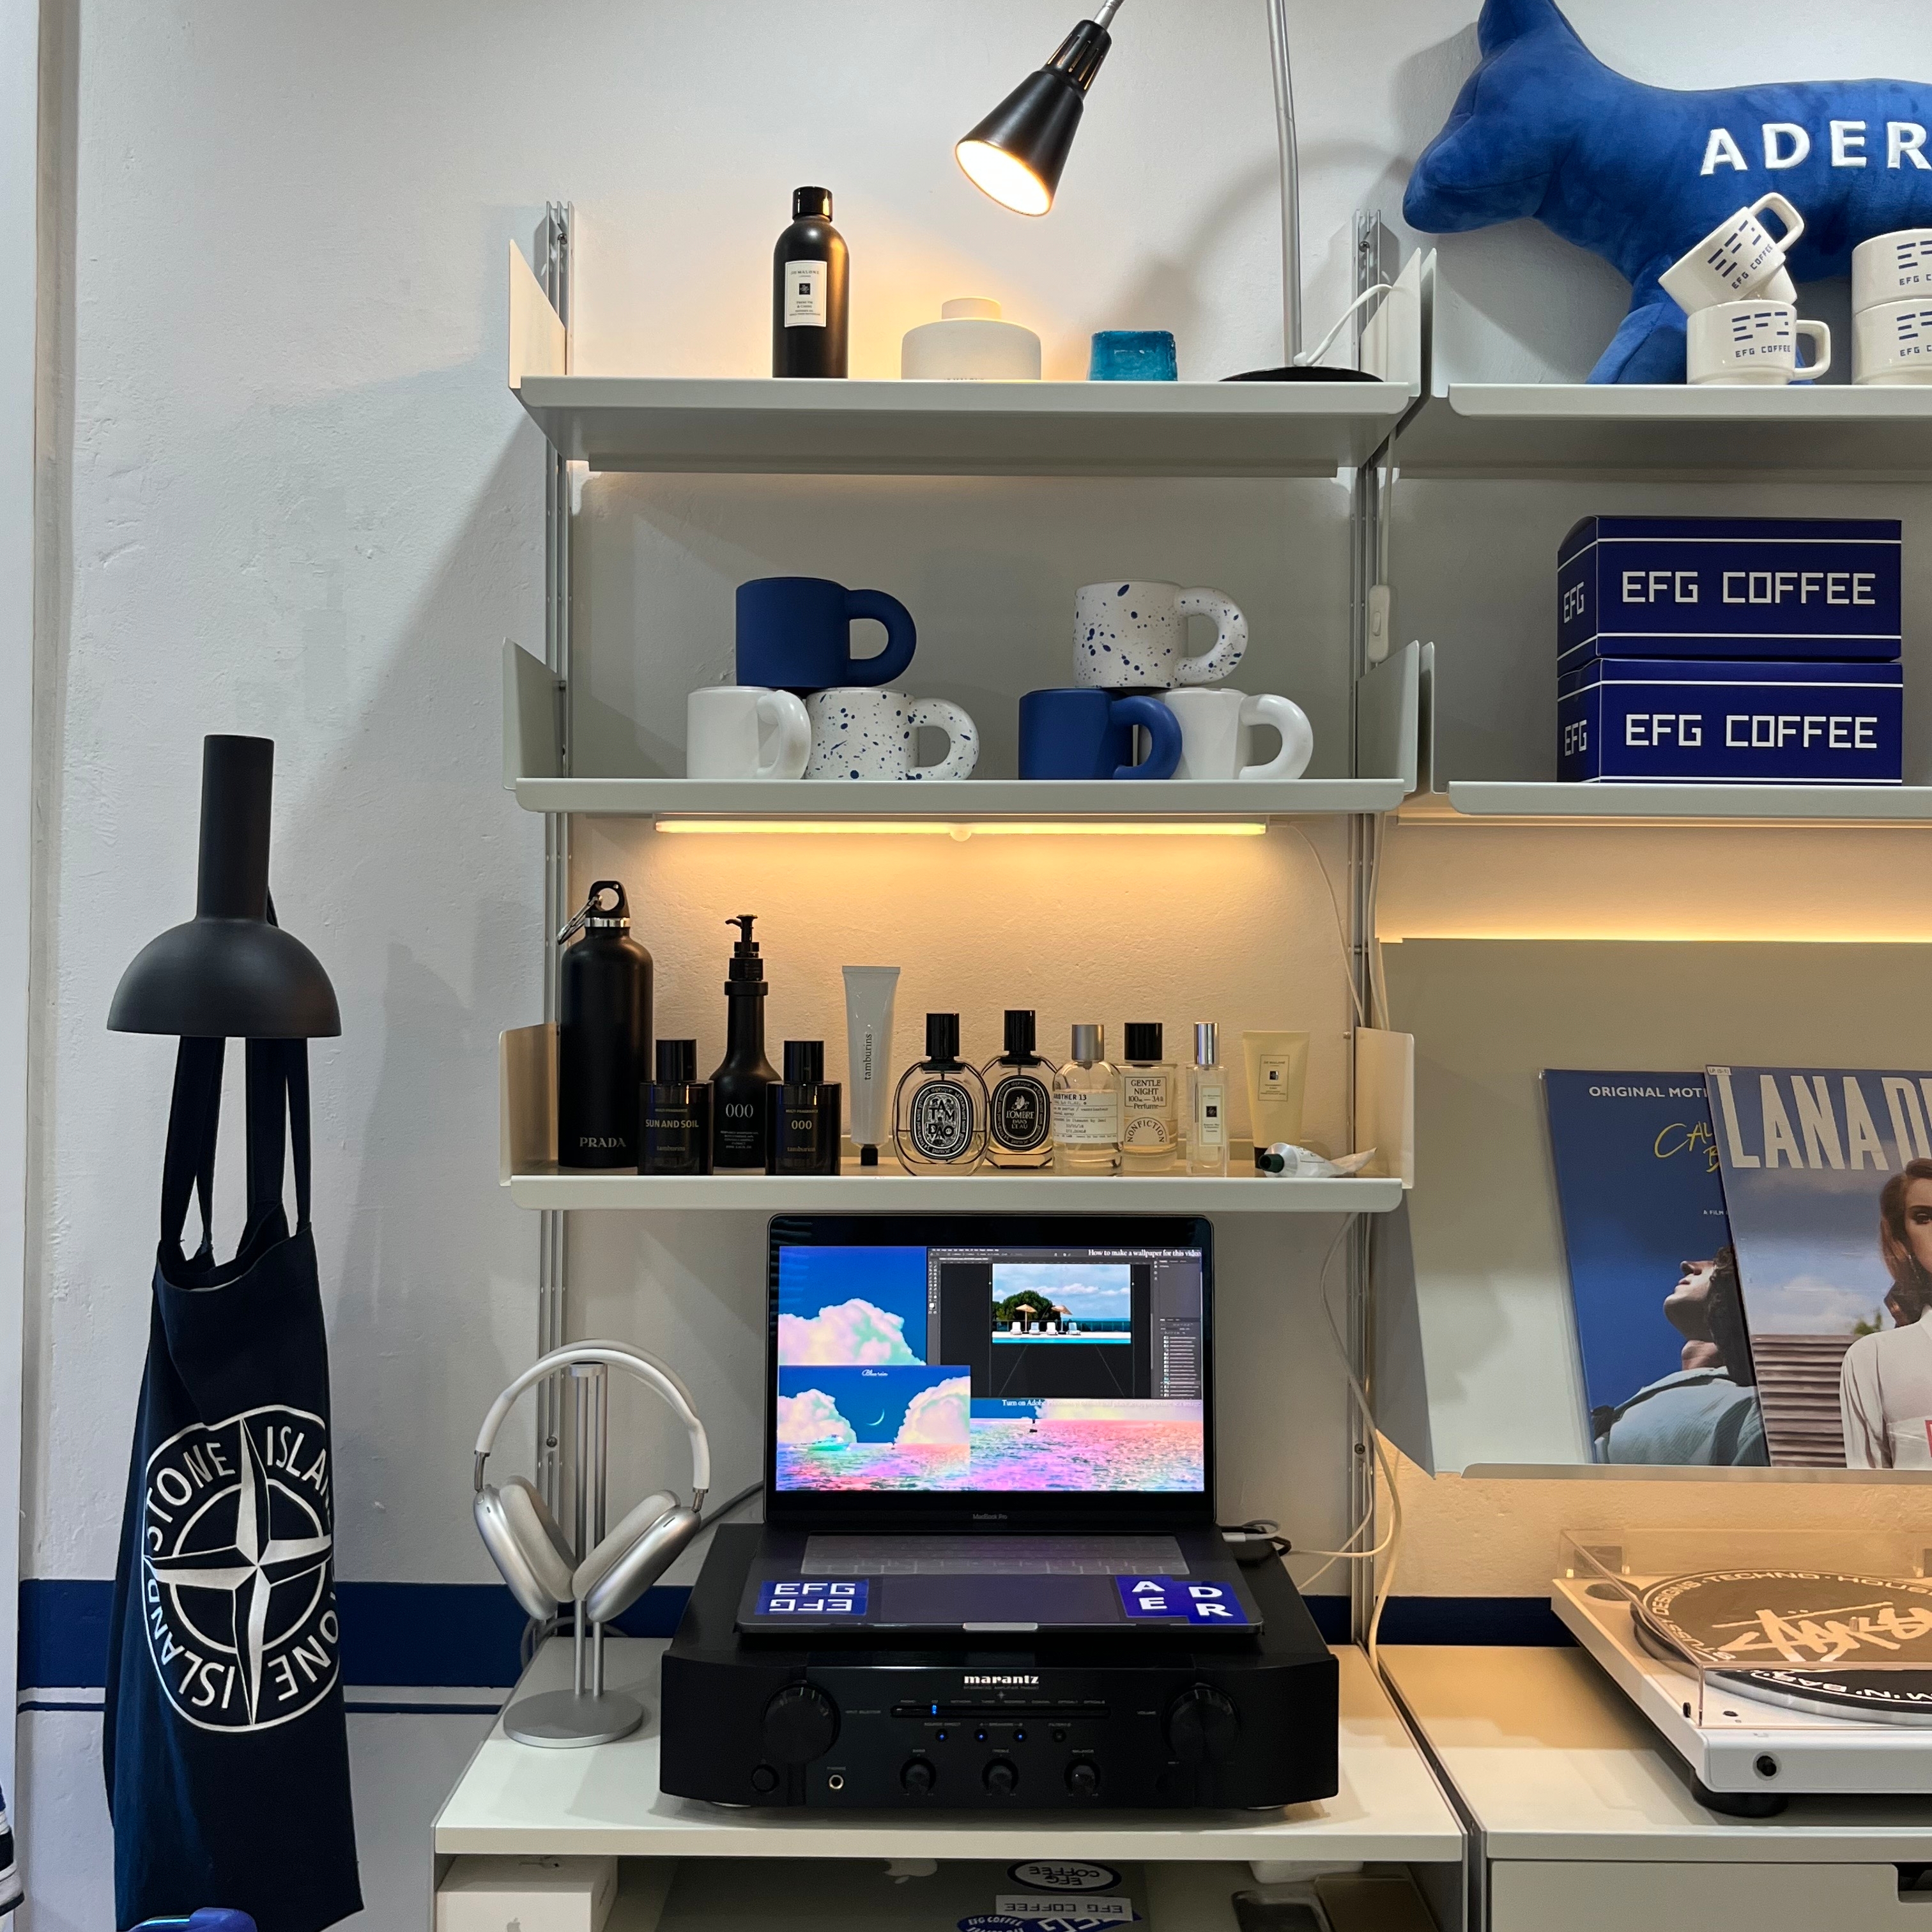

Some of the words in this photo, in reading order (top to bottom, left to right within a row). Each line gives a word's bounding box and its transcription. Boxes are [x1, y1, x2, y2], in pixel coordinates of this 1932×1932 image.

[1700, 120, 1932, 176] ADER
[1731, 272, 1749, 289] EFG
[1750, 243, 1773, 270] COFFEE
[1899, 275, 1919, 286] EFG
[1735, 348, 1755, 358] EFG
[1761, 345, 1791, 353] COFFEE
[1899, 346, 1920, 356] EFG
[1622, 571, 1698, 602] EFG
[1722, 571, 1876, 604] COFFEE
[1563, 581, 1584, 624] EFG
[1564, 719, 1587, 757] EFG
[1625, 714, 1702, 746] EFG
[1726, 715, 1878, 749] COFFEE
[864, 1033, 873, 1081] tamburins
[1589, 1086, 1665, 1098] ORIGINAL
[1668, 1087, 1707, 1098] MOTI
[725, 1103, 754, 1118] 000
[928, 1099, 955, 1121] TAM
[1006, 1110, 1034, 1119] L'OMBRE
[645, 1119, 660, 1128] SUN
[661, 1120, 680, 1128] AND
[680, 1119, 699, 1128] SOIL
[791, 1120, 813, 1130] 000
[1717, 1075, 1889, 1170] LANA
[928, 1124, 954, 1140] DAO
[1127, 1119, 1165, 1143] NONFICTION
[579, 1137, 626, 1147] PRADA
[1654, 1121, 1713, 1158] CAL
[1133, 1249, 1162, 1258] wallpaper
[146, 1442, 235, 1552] STONE
[267, 1425, 332, 1528] ISLA
[774, 1583, 855, 1595] EFG
[1704, 1572, 1820, 1583] TECHNO
[1837, 1575, 1932, 1596] HOUS
[1652, 1581, 1702, 1616] DESIGNS
[147, 1579, 235, 1710] ISLAND
[267, 1593, 339, 1701] ONE
[963, 1675, 1039, 1684] marantz
[1029, 1866, 1100, 1878] COFFEE
[1045, 1874, 1082, 1885] EFG
[1004, 1903, 1076, 1912] COFFEE
[1087, 1905, 1123, 1913] EFG
